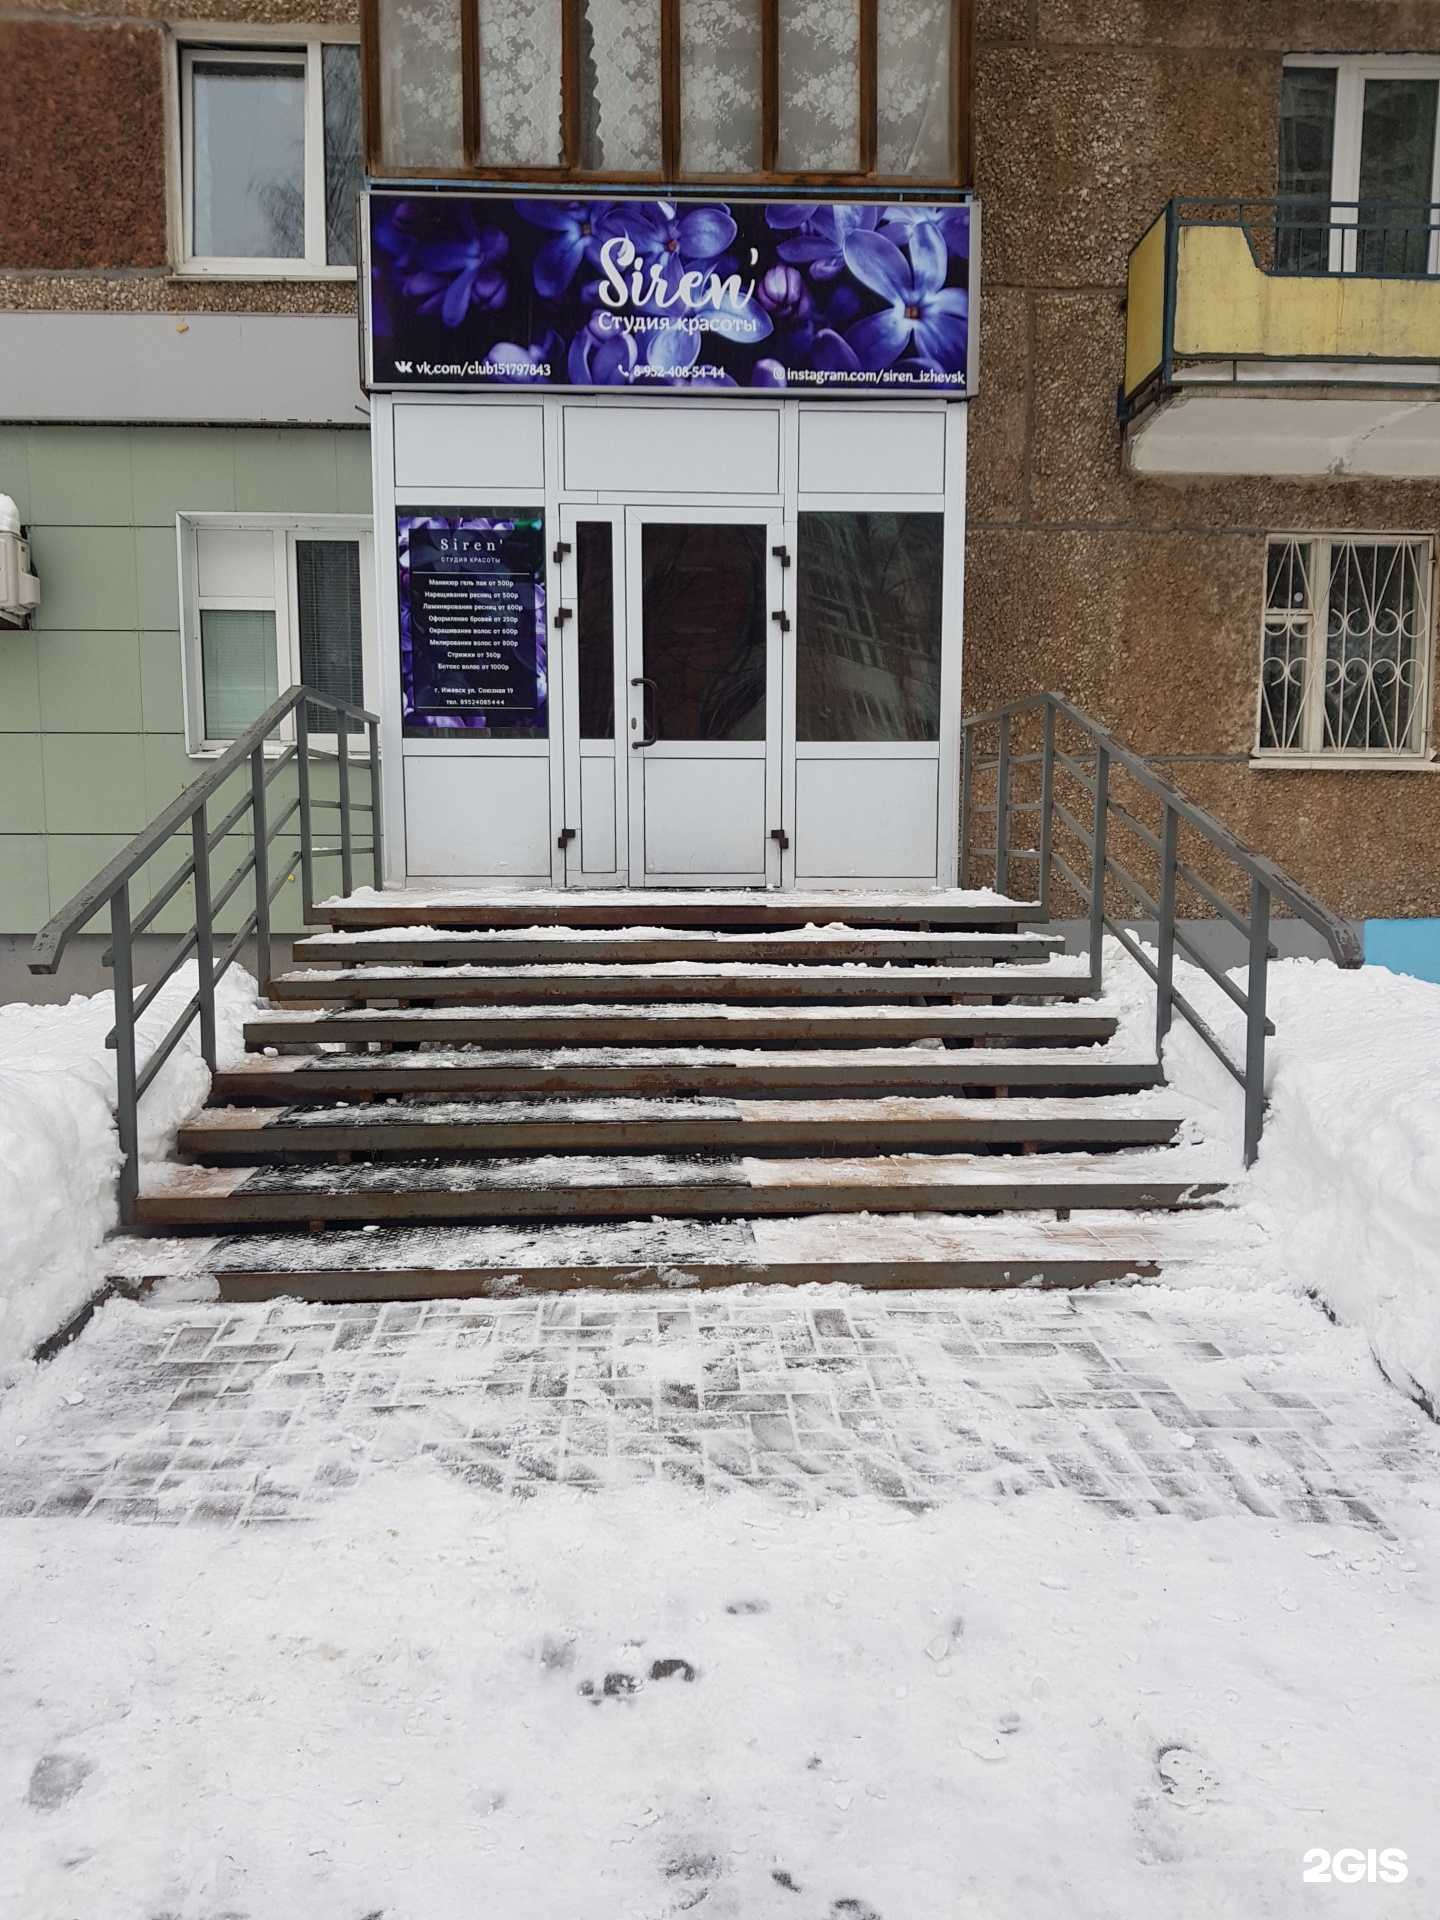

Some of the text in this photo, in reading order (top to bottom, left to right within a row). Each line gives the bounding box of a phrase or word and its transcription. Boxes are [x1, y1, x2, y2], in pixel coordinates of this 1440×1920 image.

[598, 311, 757, 335] Студия красоты
[416, 362, 551, 376] vk.com/club151797843
[633, 365, 725, 378] 8-952-408-54-44
[787, 368, 966, 385] instagram.com/siren_izhevsk
[440, 556, 501, 564] СТУДИЯ КРАСОТЫ
[428, 615, 469, 623] Оформление
[447, 651, 476, 659] Стрижки
